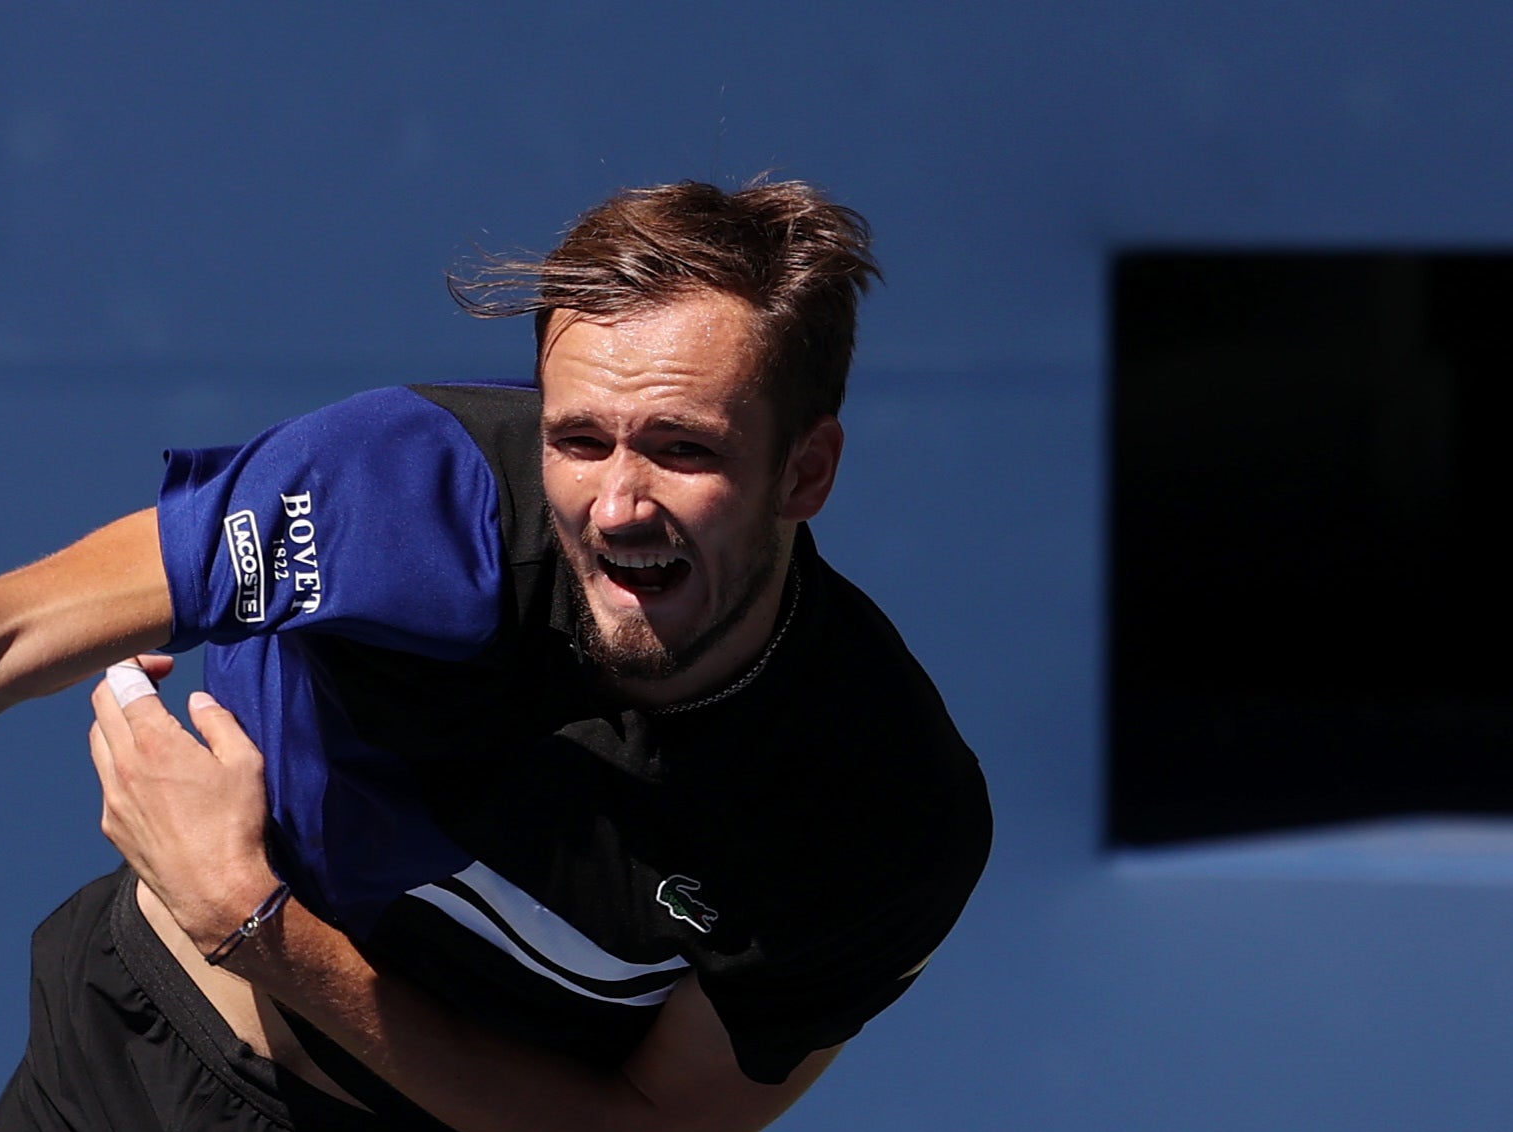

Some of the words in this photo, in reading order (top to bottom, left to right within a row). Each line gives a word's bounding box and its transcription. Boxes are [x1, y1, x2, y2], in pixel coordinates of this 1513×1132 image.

[232, 517, 258, 614] LACOSTE
[272, 538, 290, 581] 1822
[280, 490, 321, 614] BOVET
